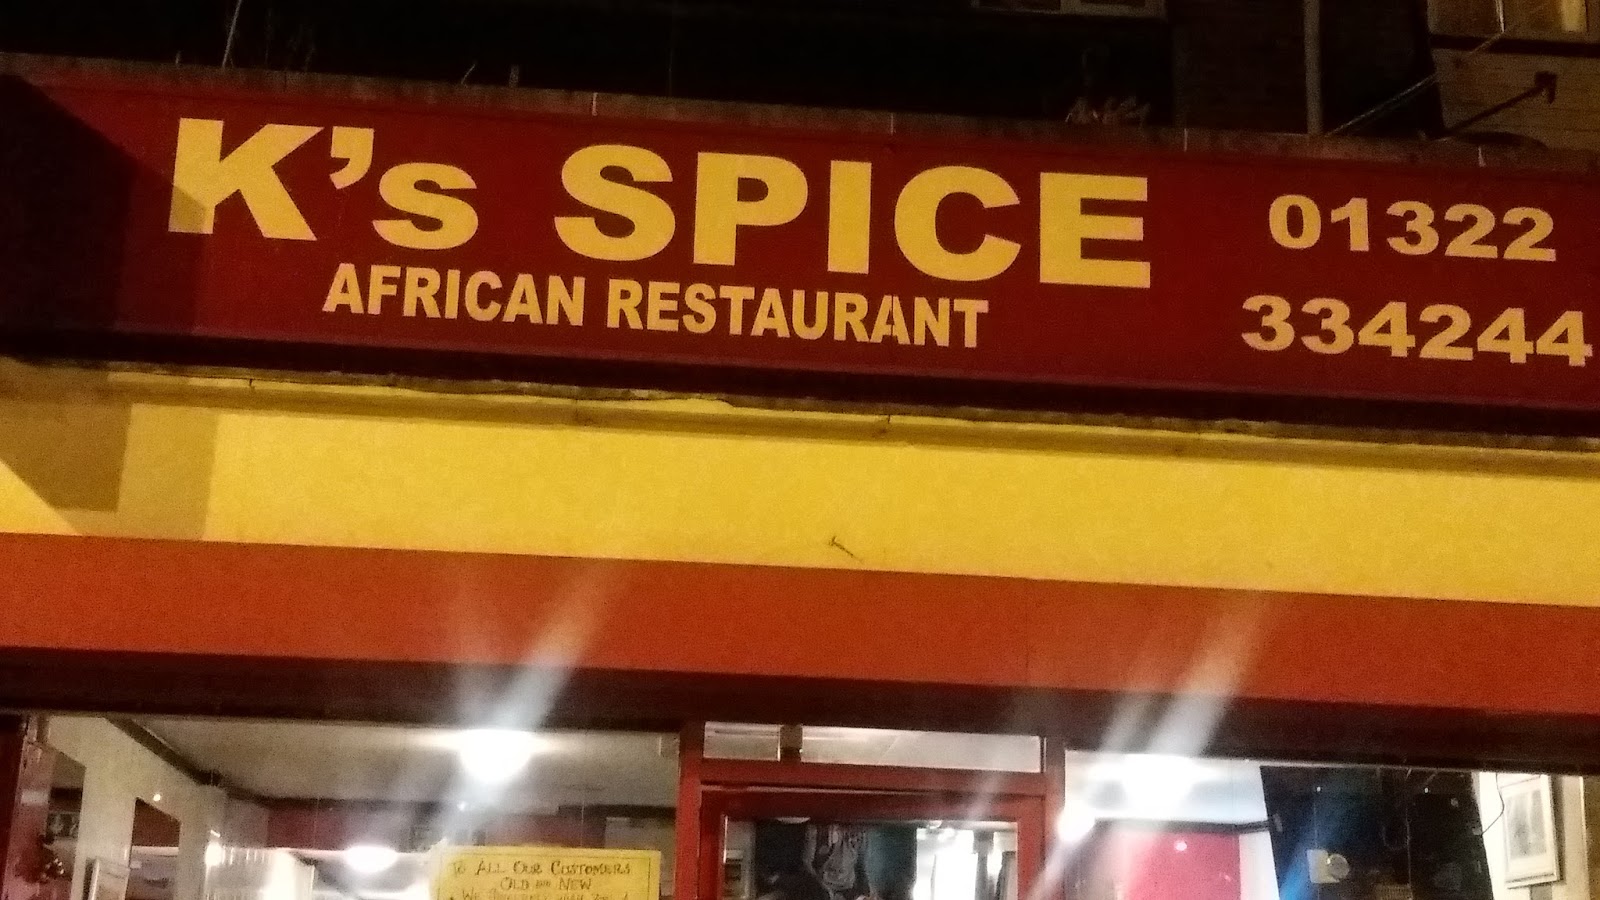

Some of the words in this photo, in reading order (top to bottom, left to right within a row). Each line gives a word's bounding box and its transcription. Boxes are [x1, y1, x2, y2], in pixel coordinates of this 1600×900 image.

[554, 144, 1151, 289] SPICE
[1268, 194, 1557, 262] 01322
[322, 263, 585, 327] AFRICAN
[606, 278, 989, 349] RESTAURANT
[1241, 295, 1593, 367] 334244
